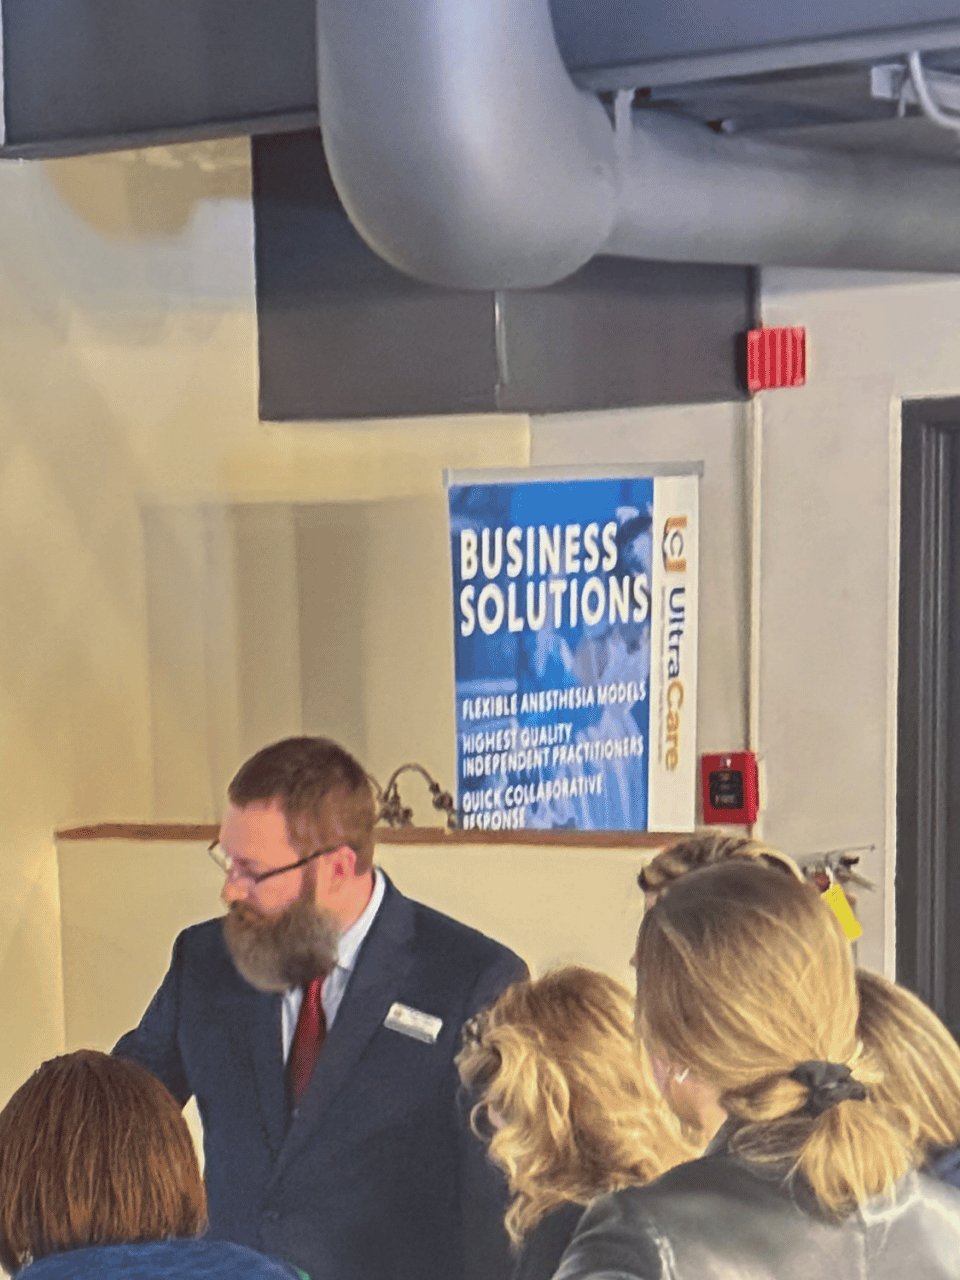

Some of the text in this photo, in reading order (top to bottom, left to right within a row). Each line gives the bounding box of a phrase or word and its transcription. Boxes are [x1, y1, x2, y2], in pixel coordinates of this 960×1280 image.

[460, 521, 618, 581] BUSINESS
[460, 574, 649, 637] SOLUTIONS
[462, 680, 646, 720] FLEXIBLE ANESTHESIA MODELS
[665, 586, 687, 772] UltraCare
[462, 722, 573, 755] HIGHEST QUALITY
[462, 735, 644, 778] INDEPENDENT PRACTITIONERS
[462, 773, 602, 813] QUICK COLLABORATIVE
